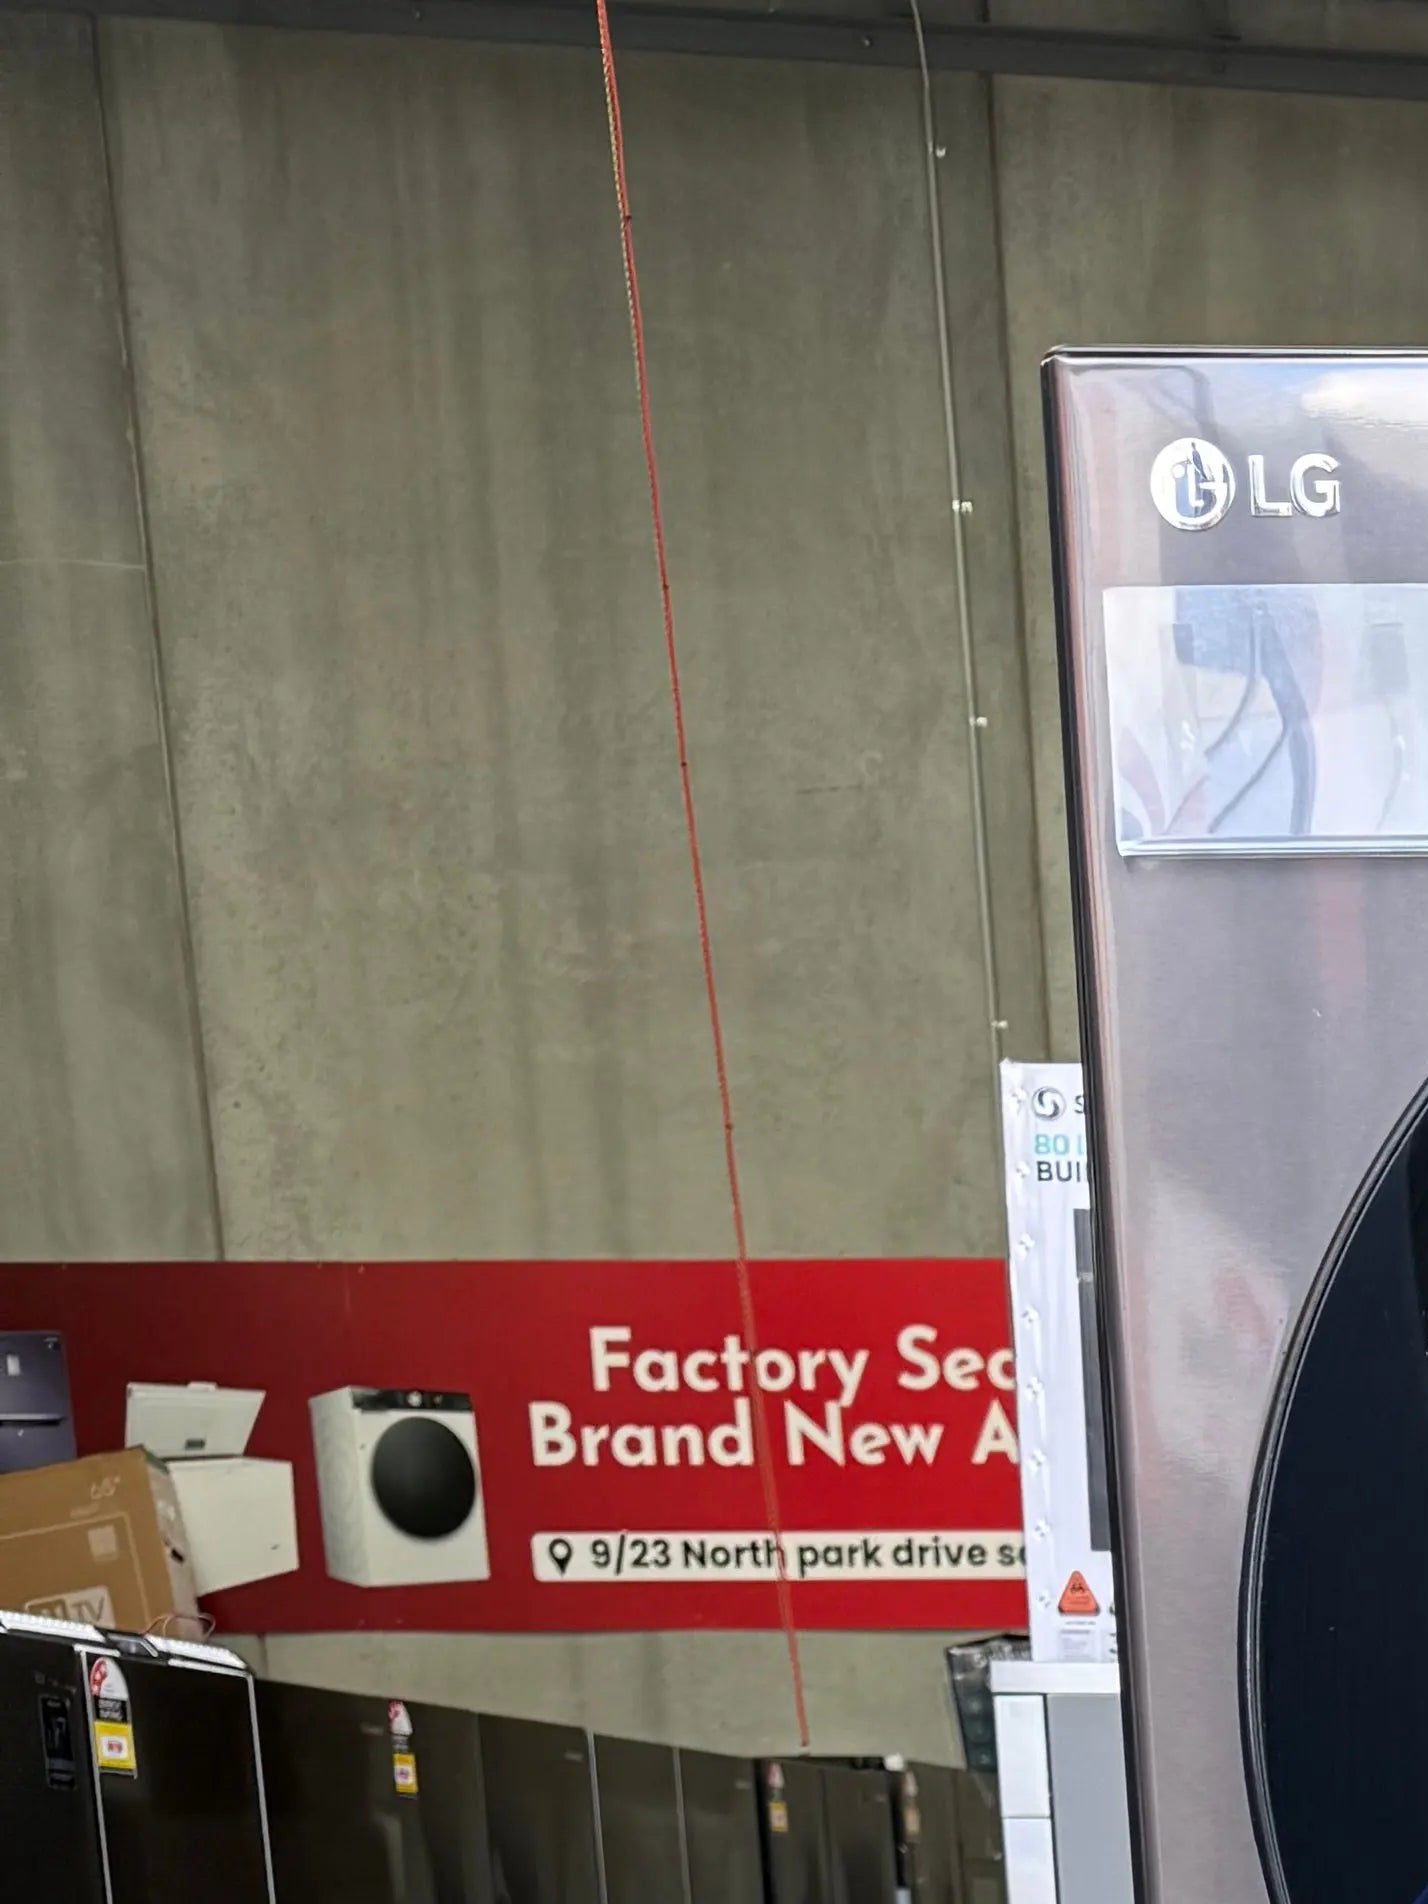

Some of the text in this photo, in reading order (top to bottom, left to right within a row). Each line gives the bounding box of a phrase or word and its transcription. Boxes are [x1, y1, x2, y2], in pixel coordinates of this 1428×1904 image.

[1248, 453, 1341, 517] LG
[590, 1326, 869, 1408] Factory
[530, 1397, 755, 1466] Brand
[785, 1400, 943, 1466] New
[591, 1534, 671, 1575] 9/23
[683, 1539, 786, 1568] North
[799, 1539, 881, 1578] park
[893, 1537, 987, 1567] drive
